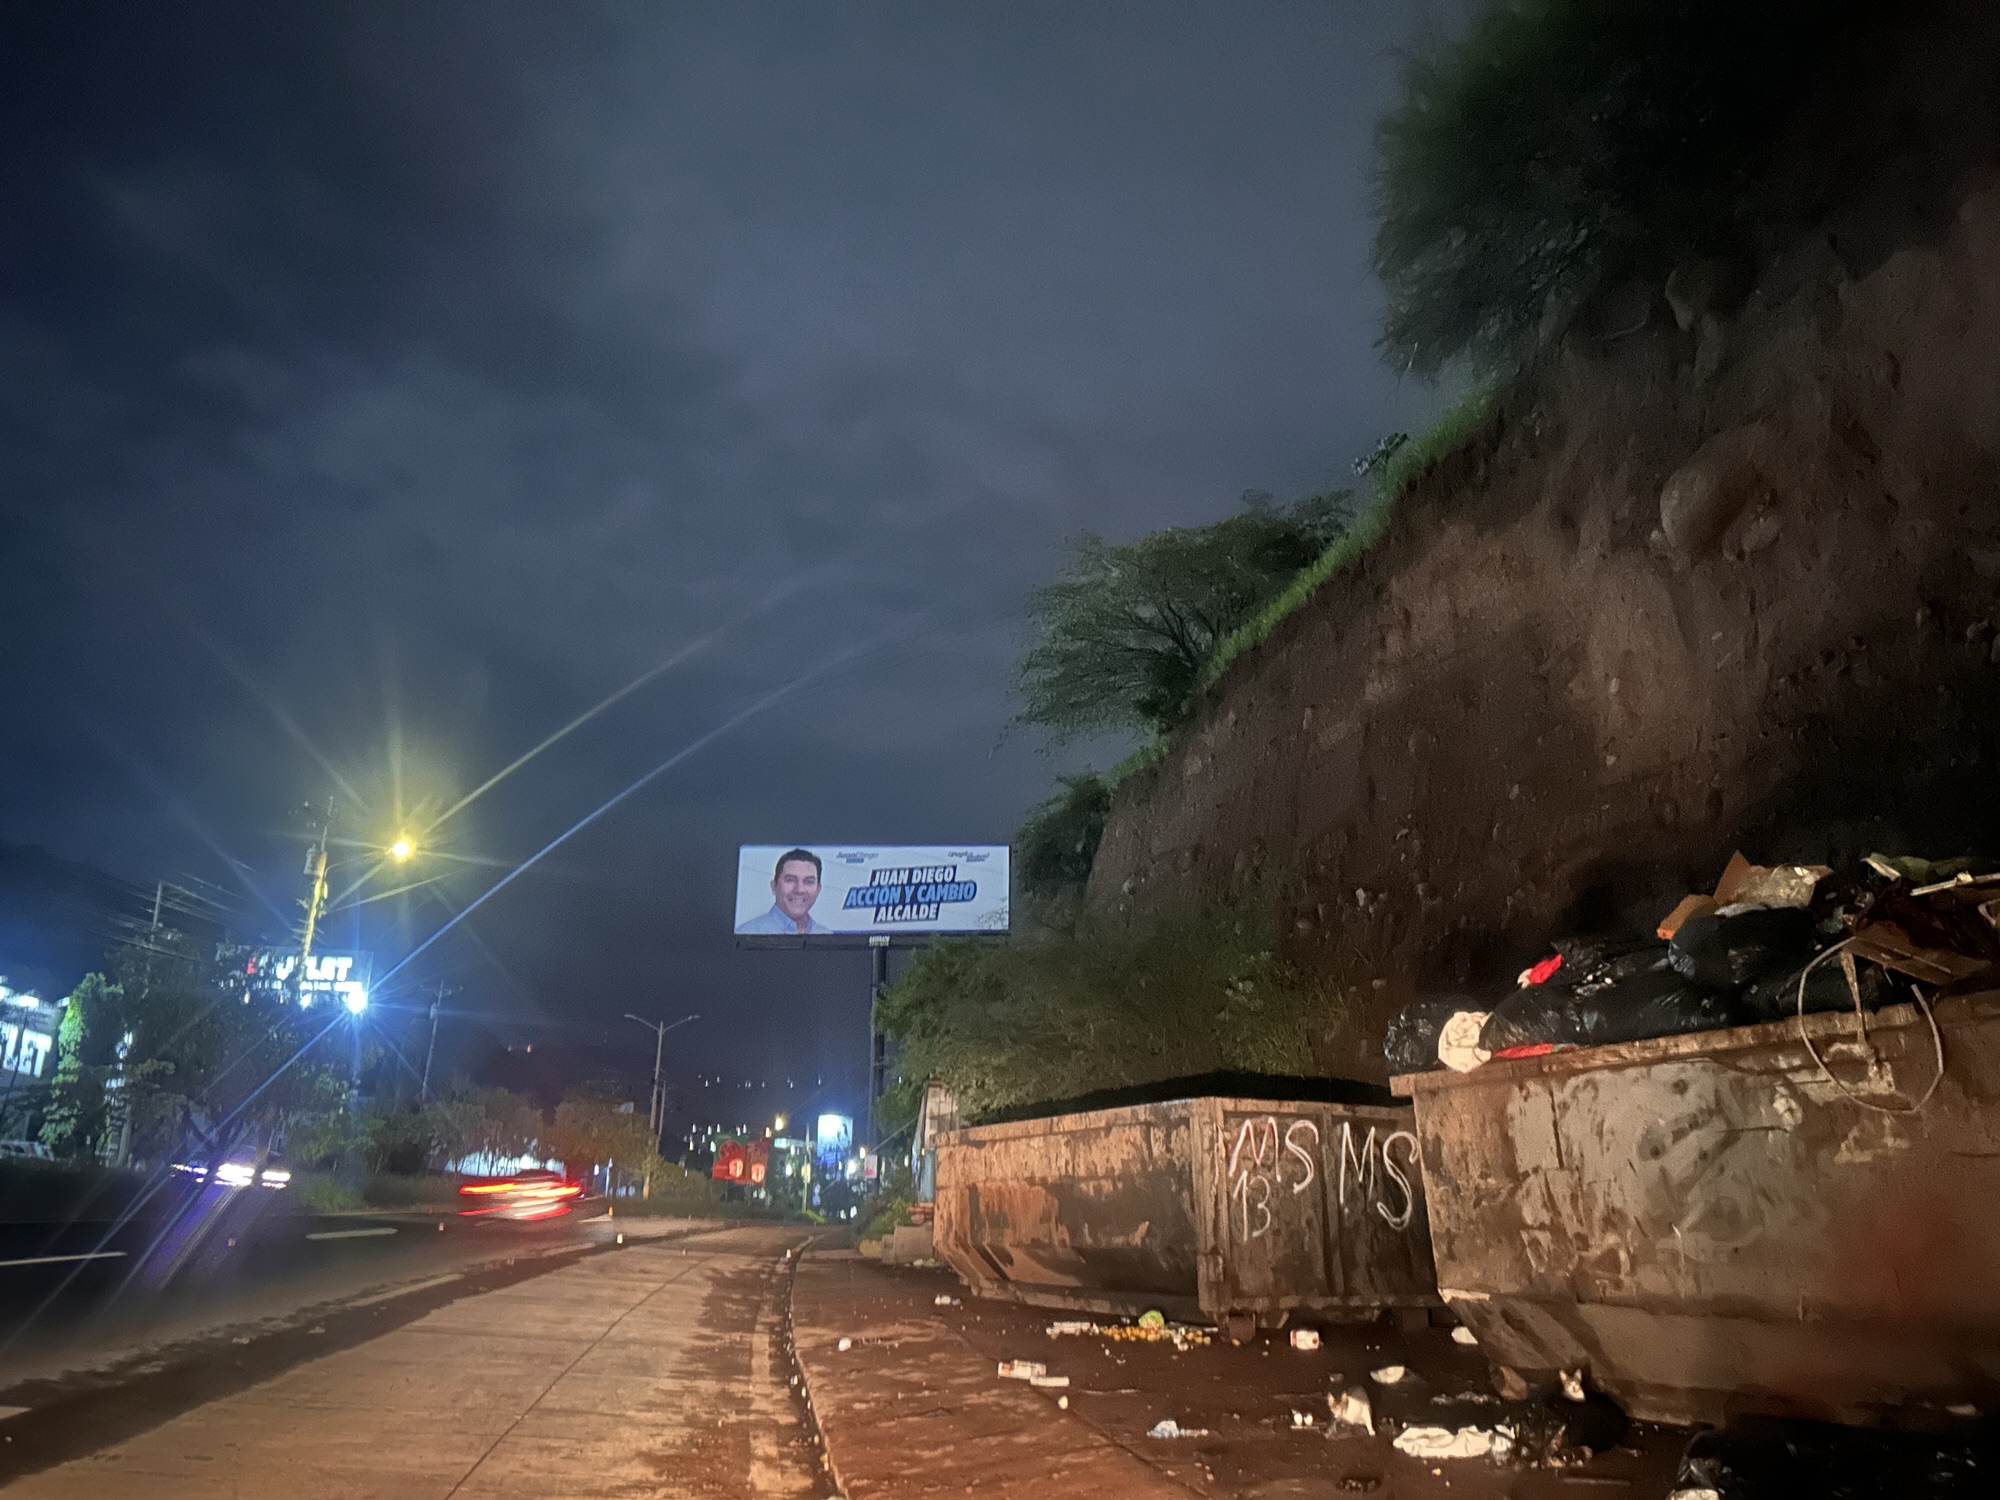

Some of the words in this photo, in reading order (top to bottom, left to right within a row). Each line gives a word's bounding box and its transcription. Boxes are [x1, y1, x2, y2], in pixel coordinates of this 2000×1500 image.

[872, 869, 909, 886] JUAN
[911, 867, 954, 883] DIEGO
[904, 885, 915, 903] Y
[916, 882, 975, 902] CAMBIO
[877, 903, 938, 921] ALCALDE
[1228, 1116, 1320, 1194] MS
[1339, 1121, 1422, 1231] MS
[1233, 1169, 1271, 1242] 13
